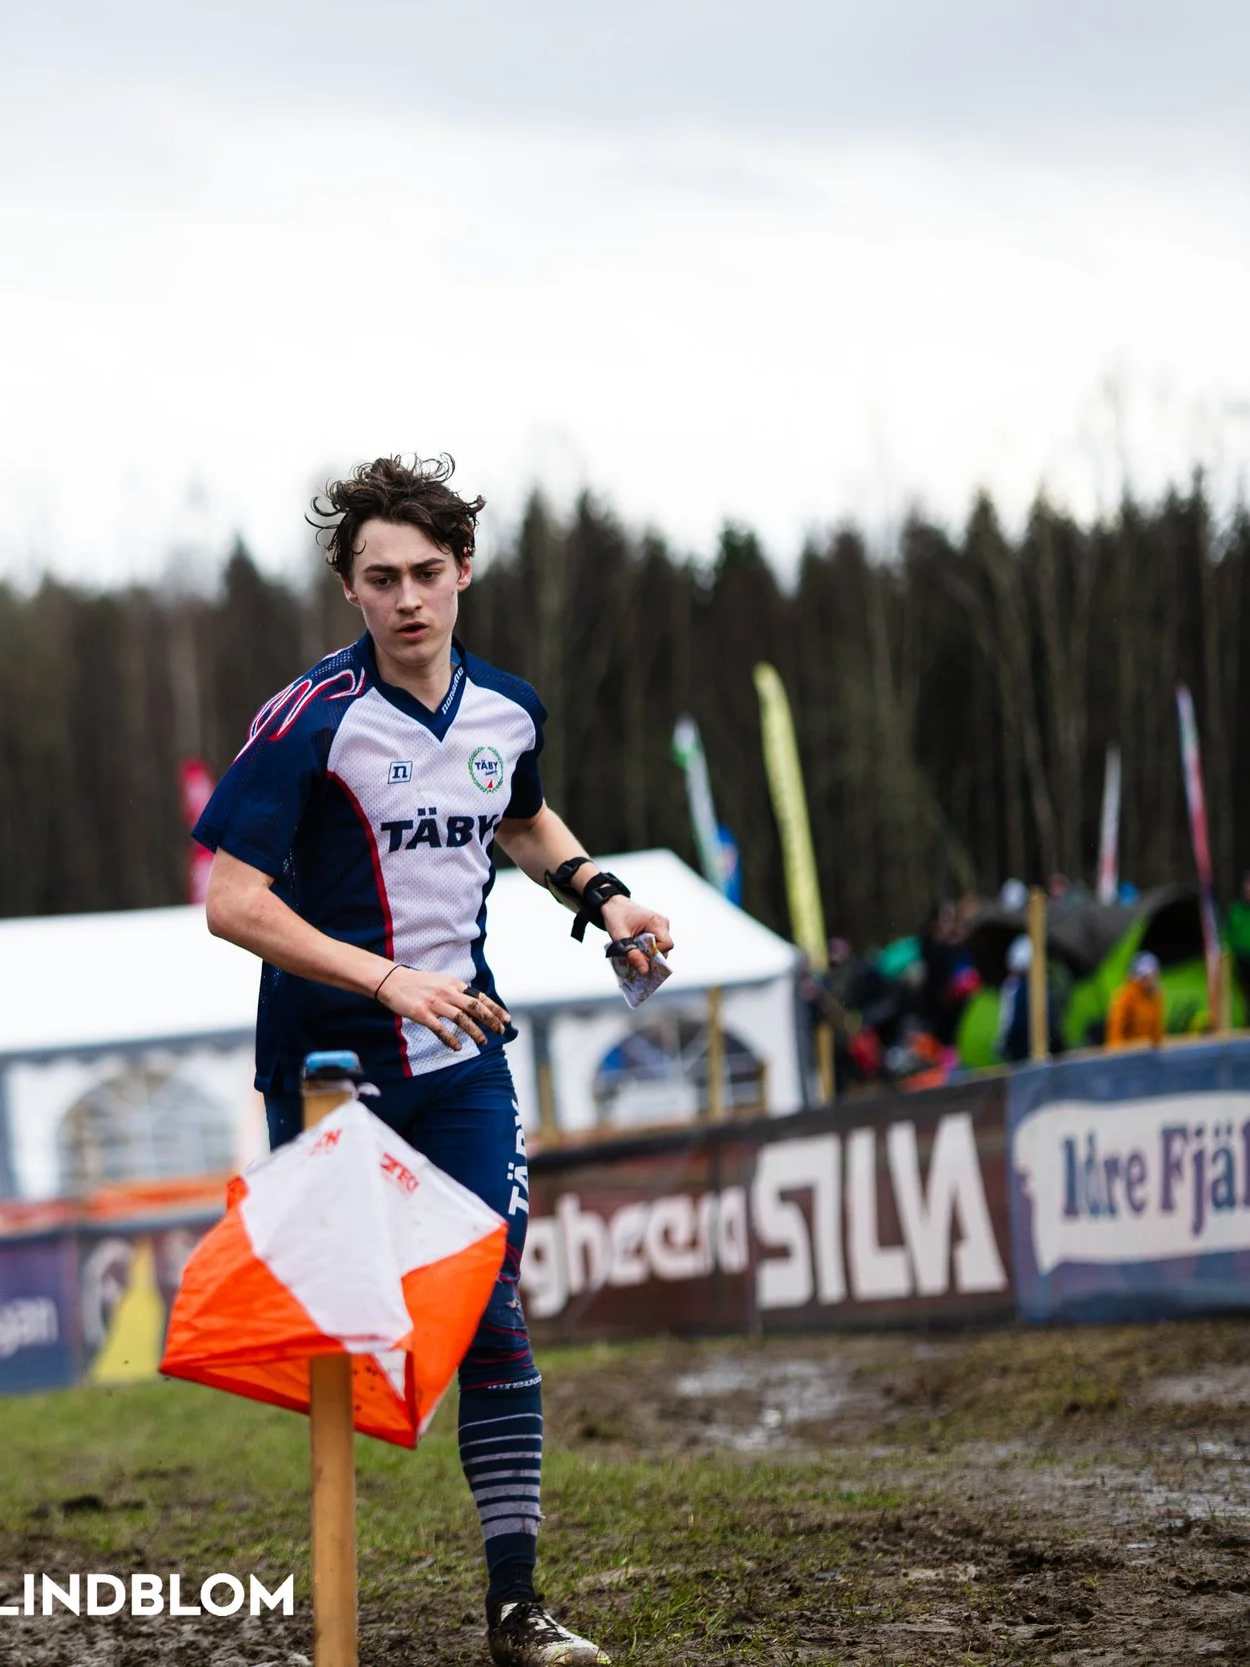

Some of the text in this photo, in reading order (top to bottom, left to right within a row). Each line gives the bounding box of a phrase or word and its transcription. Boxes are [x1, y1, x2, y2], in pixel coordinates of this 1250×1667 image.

[475, 760, 498, 771] TÄBY
[380, 807, 500, 853] TÄBY
[1062, 1128, 1146, 1218] Idre
[754, 1112, 1007, 1309] SILVA
